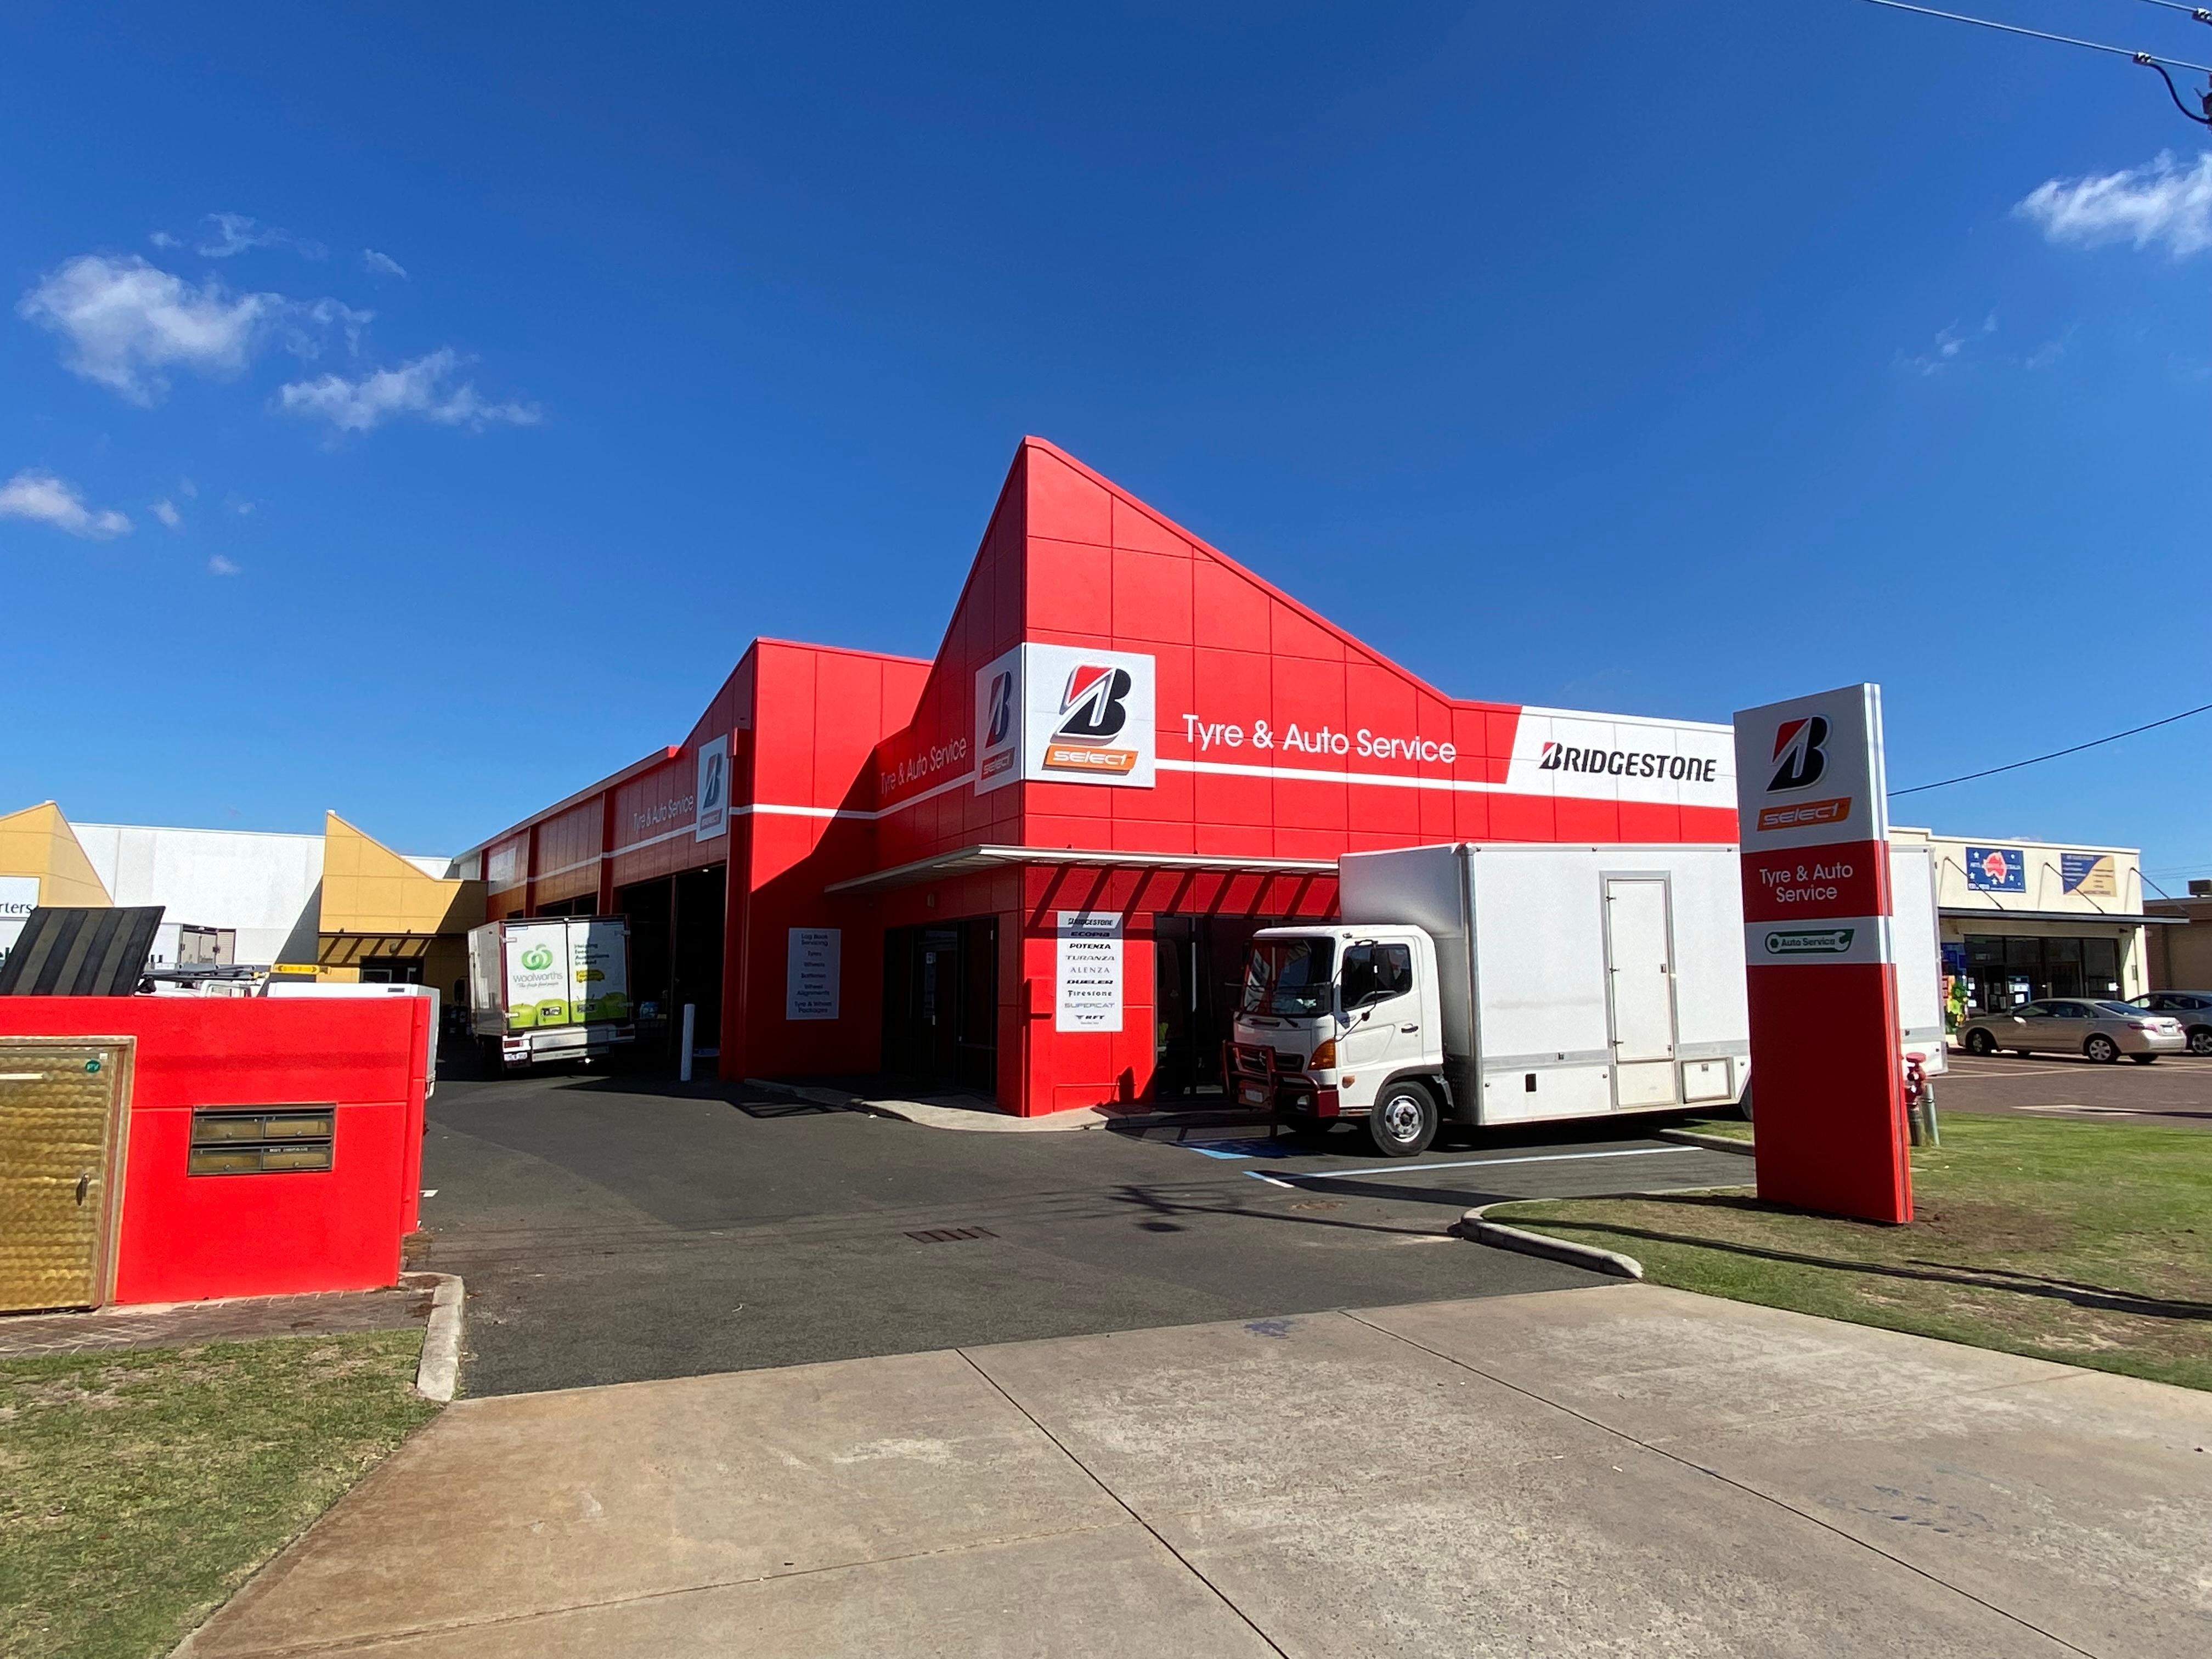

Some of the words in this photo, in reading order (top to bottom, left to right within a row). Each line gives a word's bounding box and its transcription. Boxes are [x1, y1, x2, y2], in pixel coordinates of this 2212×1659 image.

[1182, 714, 1244, 751] Tyre
[1252, 720, 1274, 749] &
[1282, 723, 1350, 755] Auto
[1356, 728, 1457, 764] Service
[881, 771, 896, 798] Tyre
[898, 762, 905, 786] &
[906, 753, 928, 782] Auto
[929, 737, 967, 772] Service
[1053, 751, 1128, 766] select
[1538, 742, 1718, 782] BRIDGESTONE
[634, 812, 646, 834] Tyre
[652, 803, 668, 825] Auto
[668, 794, 694, 819] Service
[1763, 803, 1838, 826] select
[1759, 869, 1791, 888] Tyre
[1796, 865, 1809, 882] &
[1813, 862, 1853, 881] Auto
[1776, 884, 1838, 902] Service
[1781, 938, 1801, 946] Auto
[1802, 937, 1836, 946] Service
